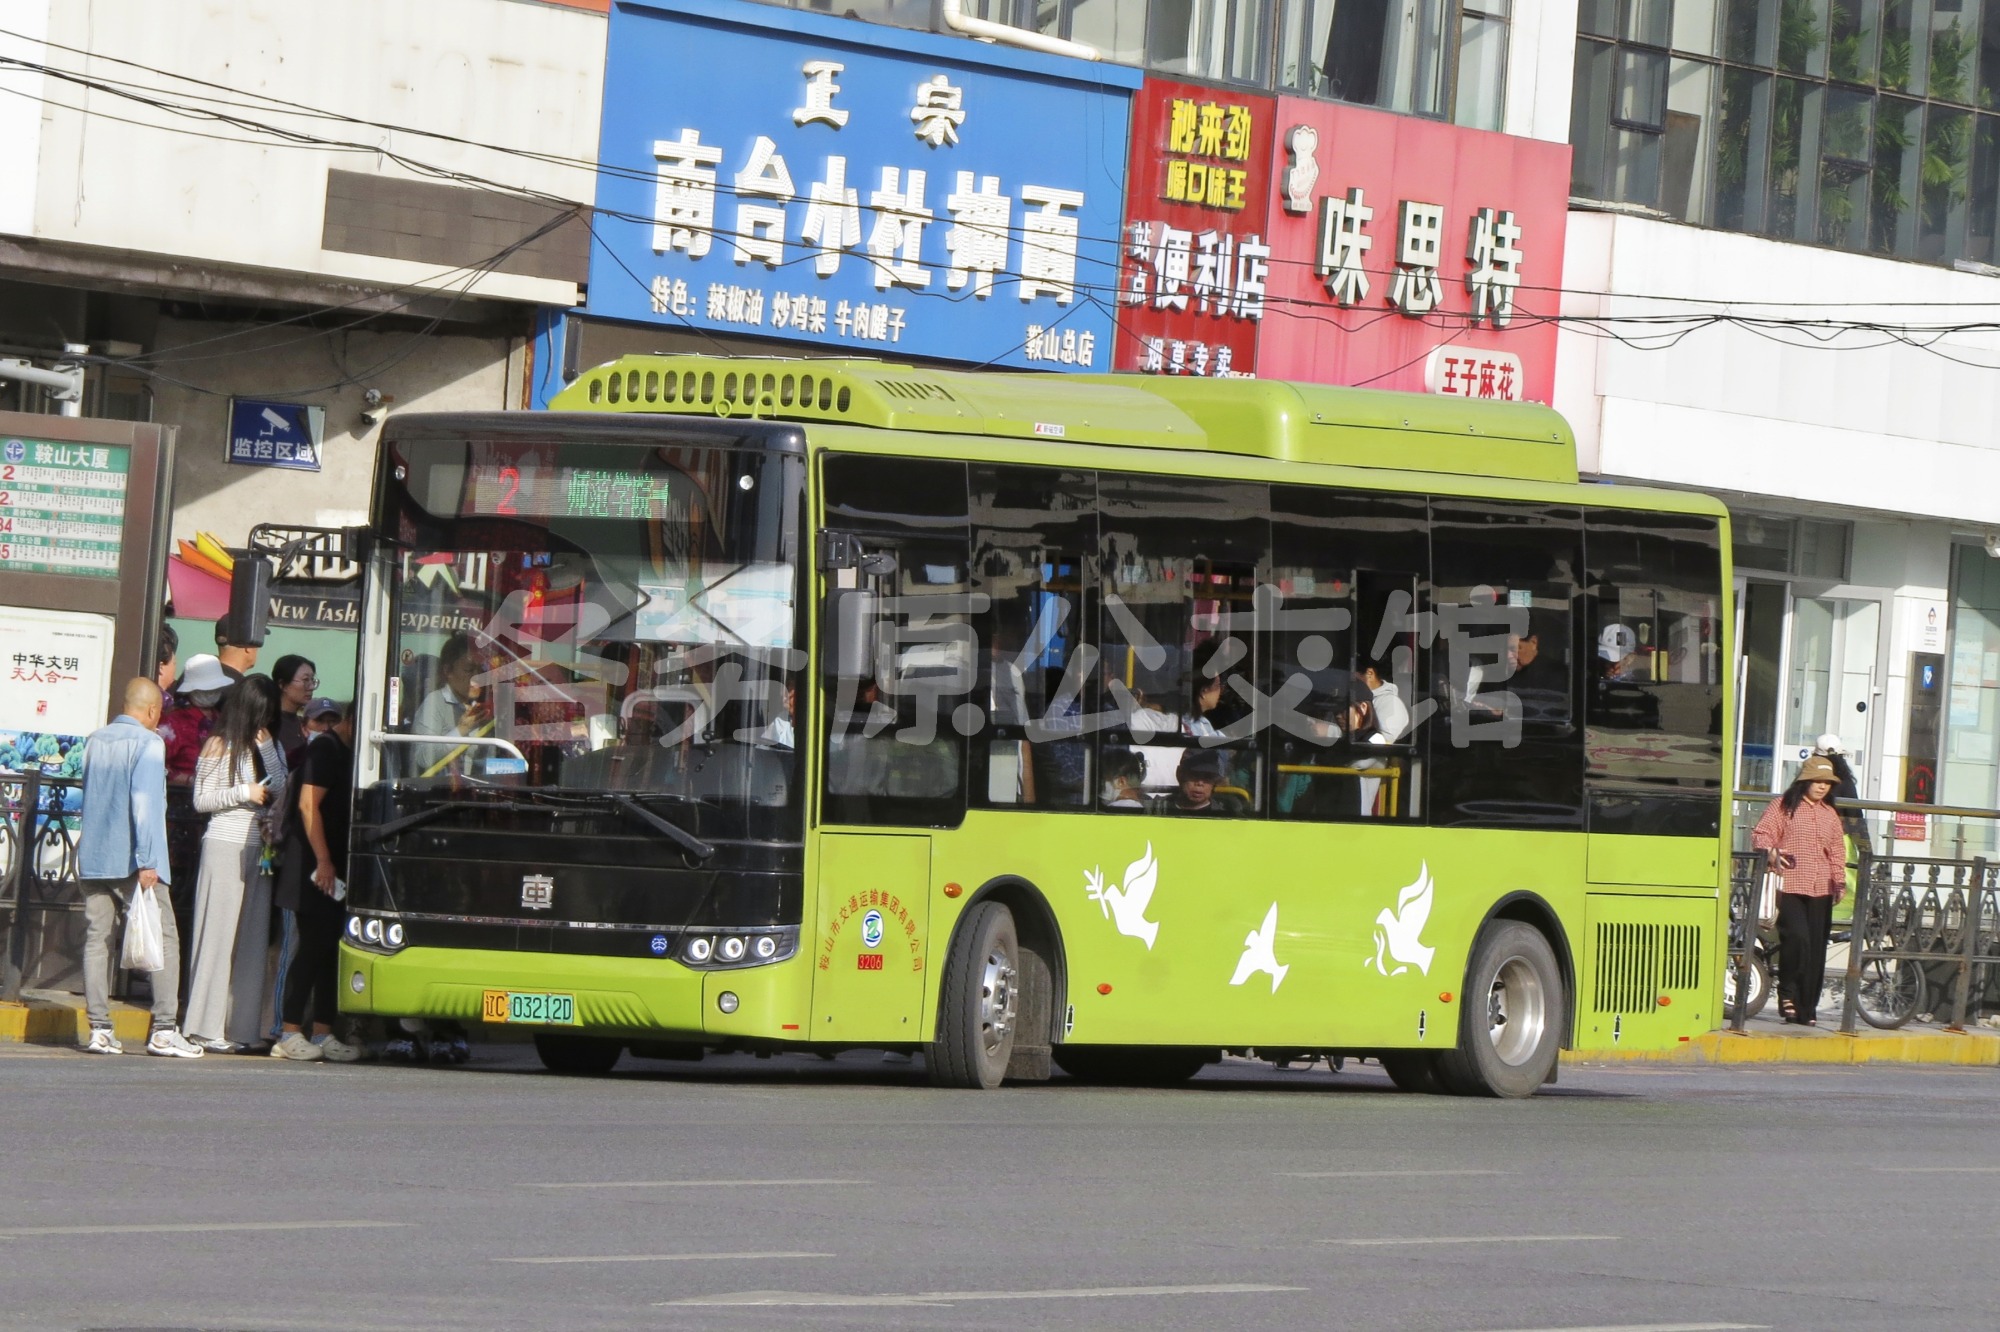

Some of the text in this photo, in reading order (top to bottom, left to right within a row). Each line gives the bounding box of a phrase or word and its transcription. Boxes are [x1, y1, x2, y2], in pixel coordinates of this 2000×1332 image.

[793, 61, 966, 146] 正宗
[1154, 222, 1271, 319] 便利店
[1315, 187, 1524, 328] 味思特
[706, 283, 764, 326] 辣椒油
[770, 291, 827, 334] 炒鸡架
[834, 300, 906, 342] 牛肉腱子
[1025, 325, 1095, 367] 鞍山总店
[1146, 337, 1233, 378] 烟草专卖
[1441, 357, 1515, 400] 王子麻花
[35, 443, 110, 469] 鞍山大厦
[232, 438, 316, 463] 监控区域
[2, 465, 15, 480] 2
[497, 467, 520, 515] 2
[11, 666, 78, 684] 天人合一
[13, 652, 79, 672] 中华文明
